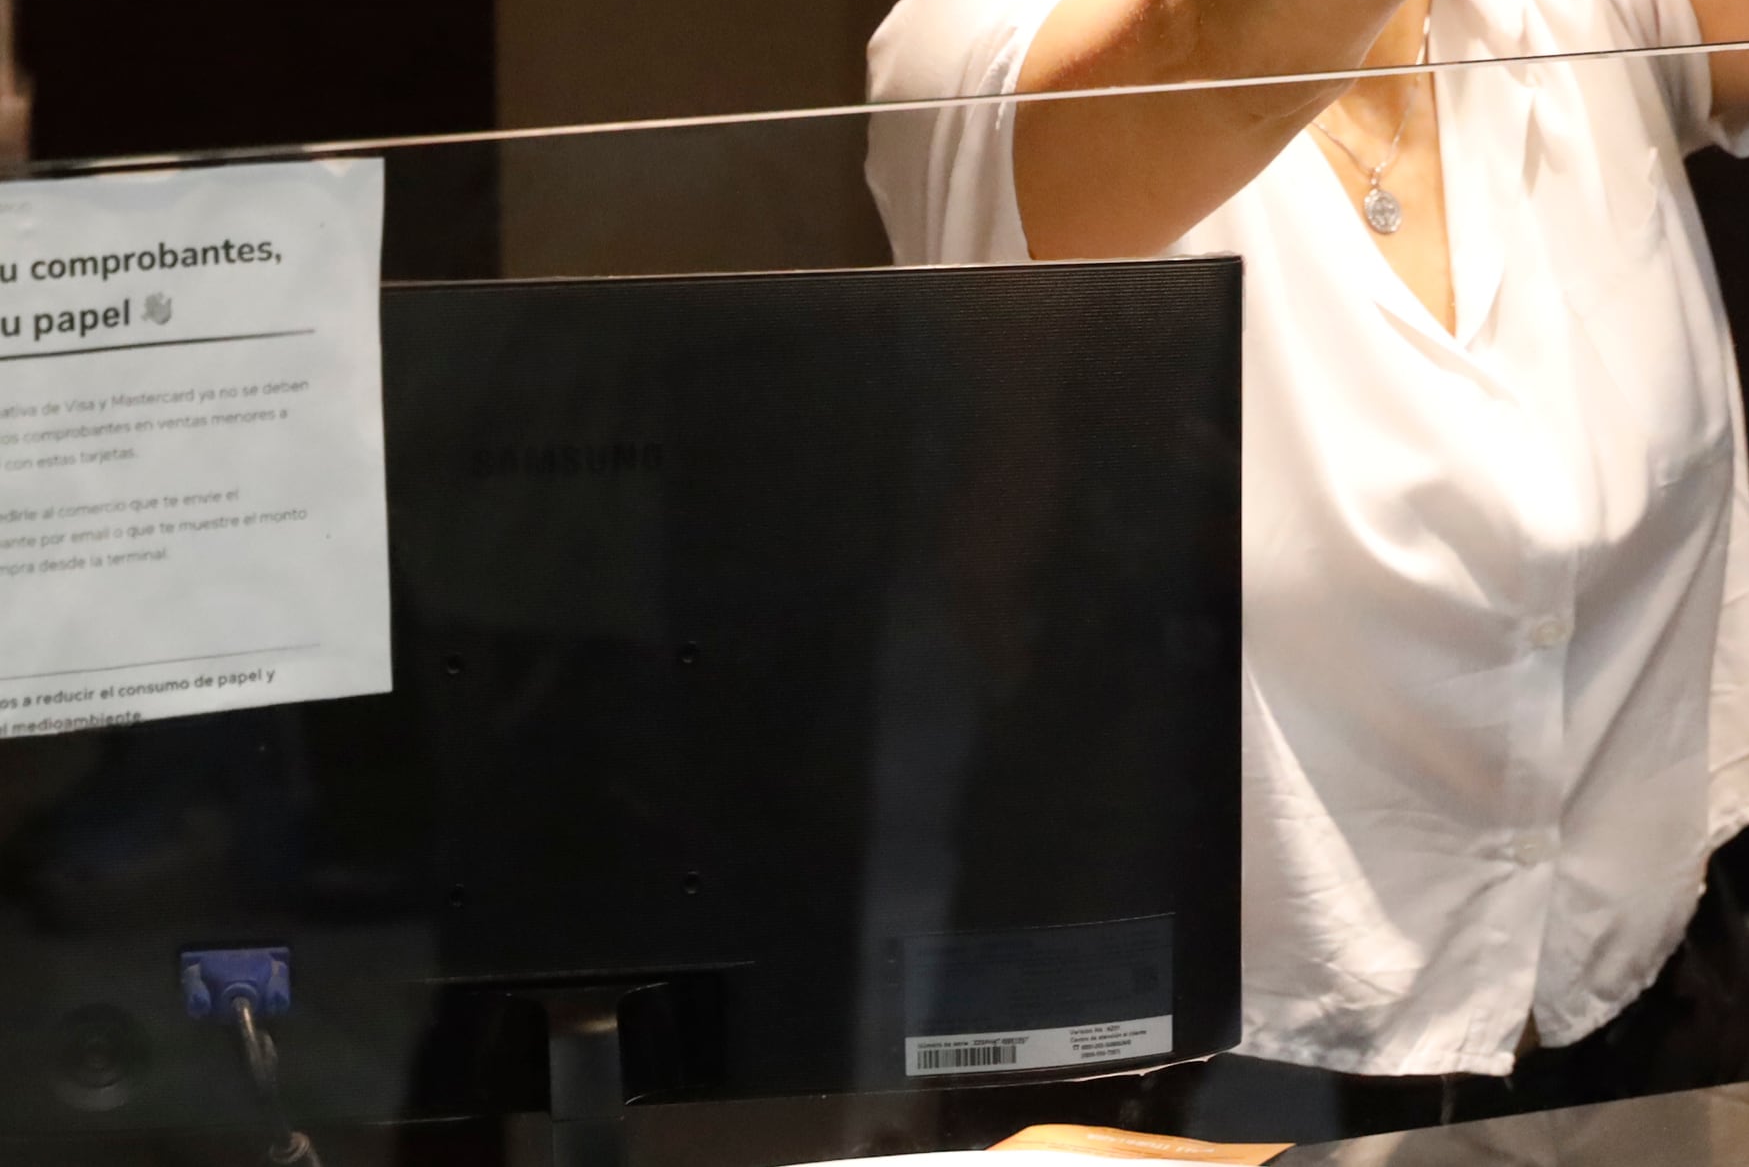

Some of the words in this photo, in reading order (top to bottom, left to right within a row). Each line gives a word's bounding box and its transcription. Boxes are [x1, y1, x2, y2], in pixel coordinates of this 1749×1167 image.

[31, 238, 282, 280] comprobantes,
[34, 299, 131, 341] papel
[42, 402, 59, 416] de
[66, 399, 94, 413] Visa
[99, 400, 107, 413] y
[111, 388, 194, 408] Mastercard
[219, 387, 237, 400] no
[243, 384, 258, 398] se
[262, 379, 309, 396] deben
[24, 421, 130, 446] comprobantes
[135, 420, 153, 432] en
[157, 415, 207, 431] ventas
[211, 410, 275, 425] menores
[5, 458, 32, 472] con
[36, 454, 76, 469] estas
[42, 506, 54, 521] al
[58, 499, 126, 519] comercio
[129, 497, 158, 514] que
[163, 495, 178, 509] te
[226, 488, 239, 503] el
[40, 531, 65, 550] por
[71, 525, 110, 544] email
[127, 523, 155, 541] que
[159, 521, 174, 535] te
[178, 514, 240, 532] muestre
[243, 512, 256, 527] el
[259, 508, 309, 527] monto
[39, 555, 85, 572] desde
[90, 552, 102, 568] la
[22, 696, 32, 708] a
[35, 688, 95, 706] reducir
[100, 686, 114, 700] el
[118, 679, 189, 698] consumo
[194, 674, 213, 689] de
[218, 669, 262, 690] papel
[266, 668, 276, 684] y
